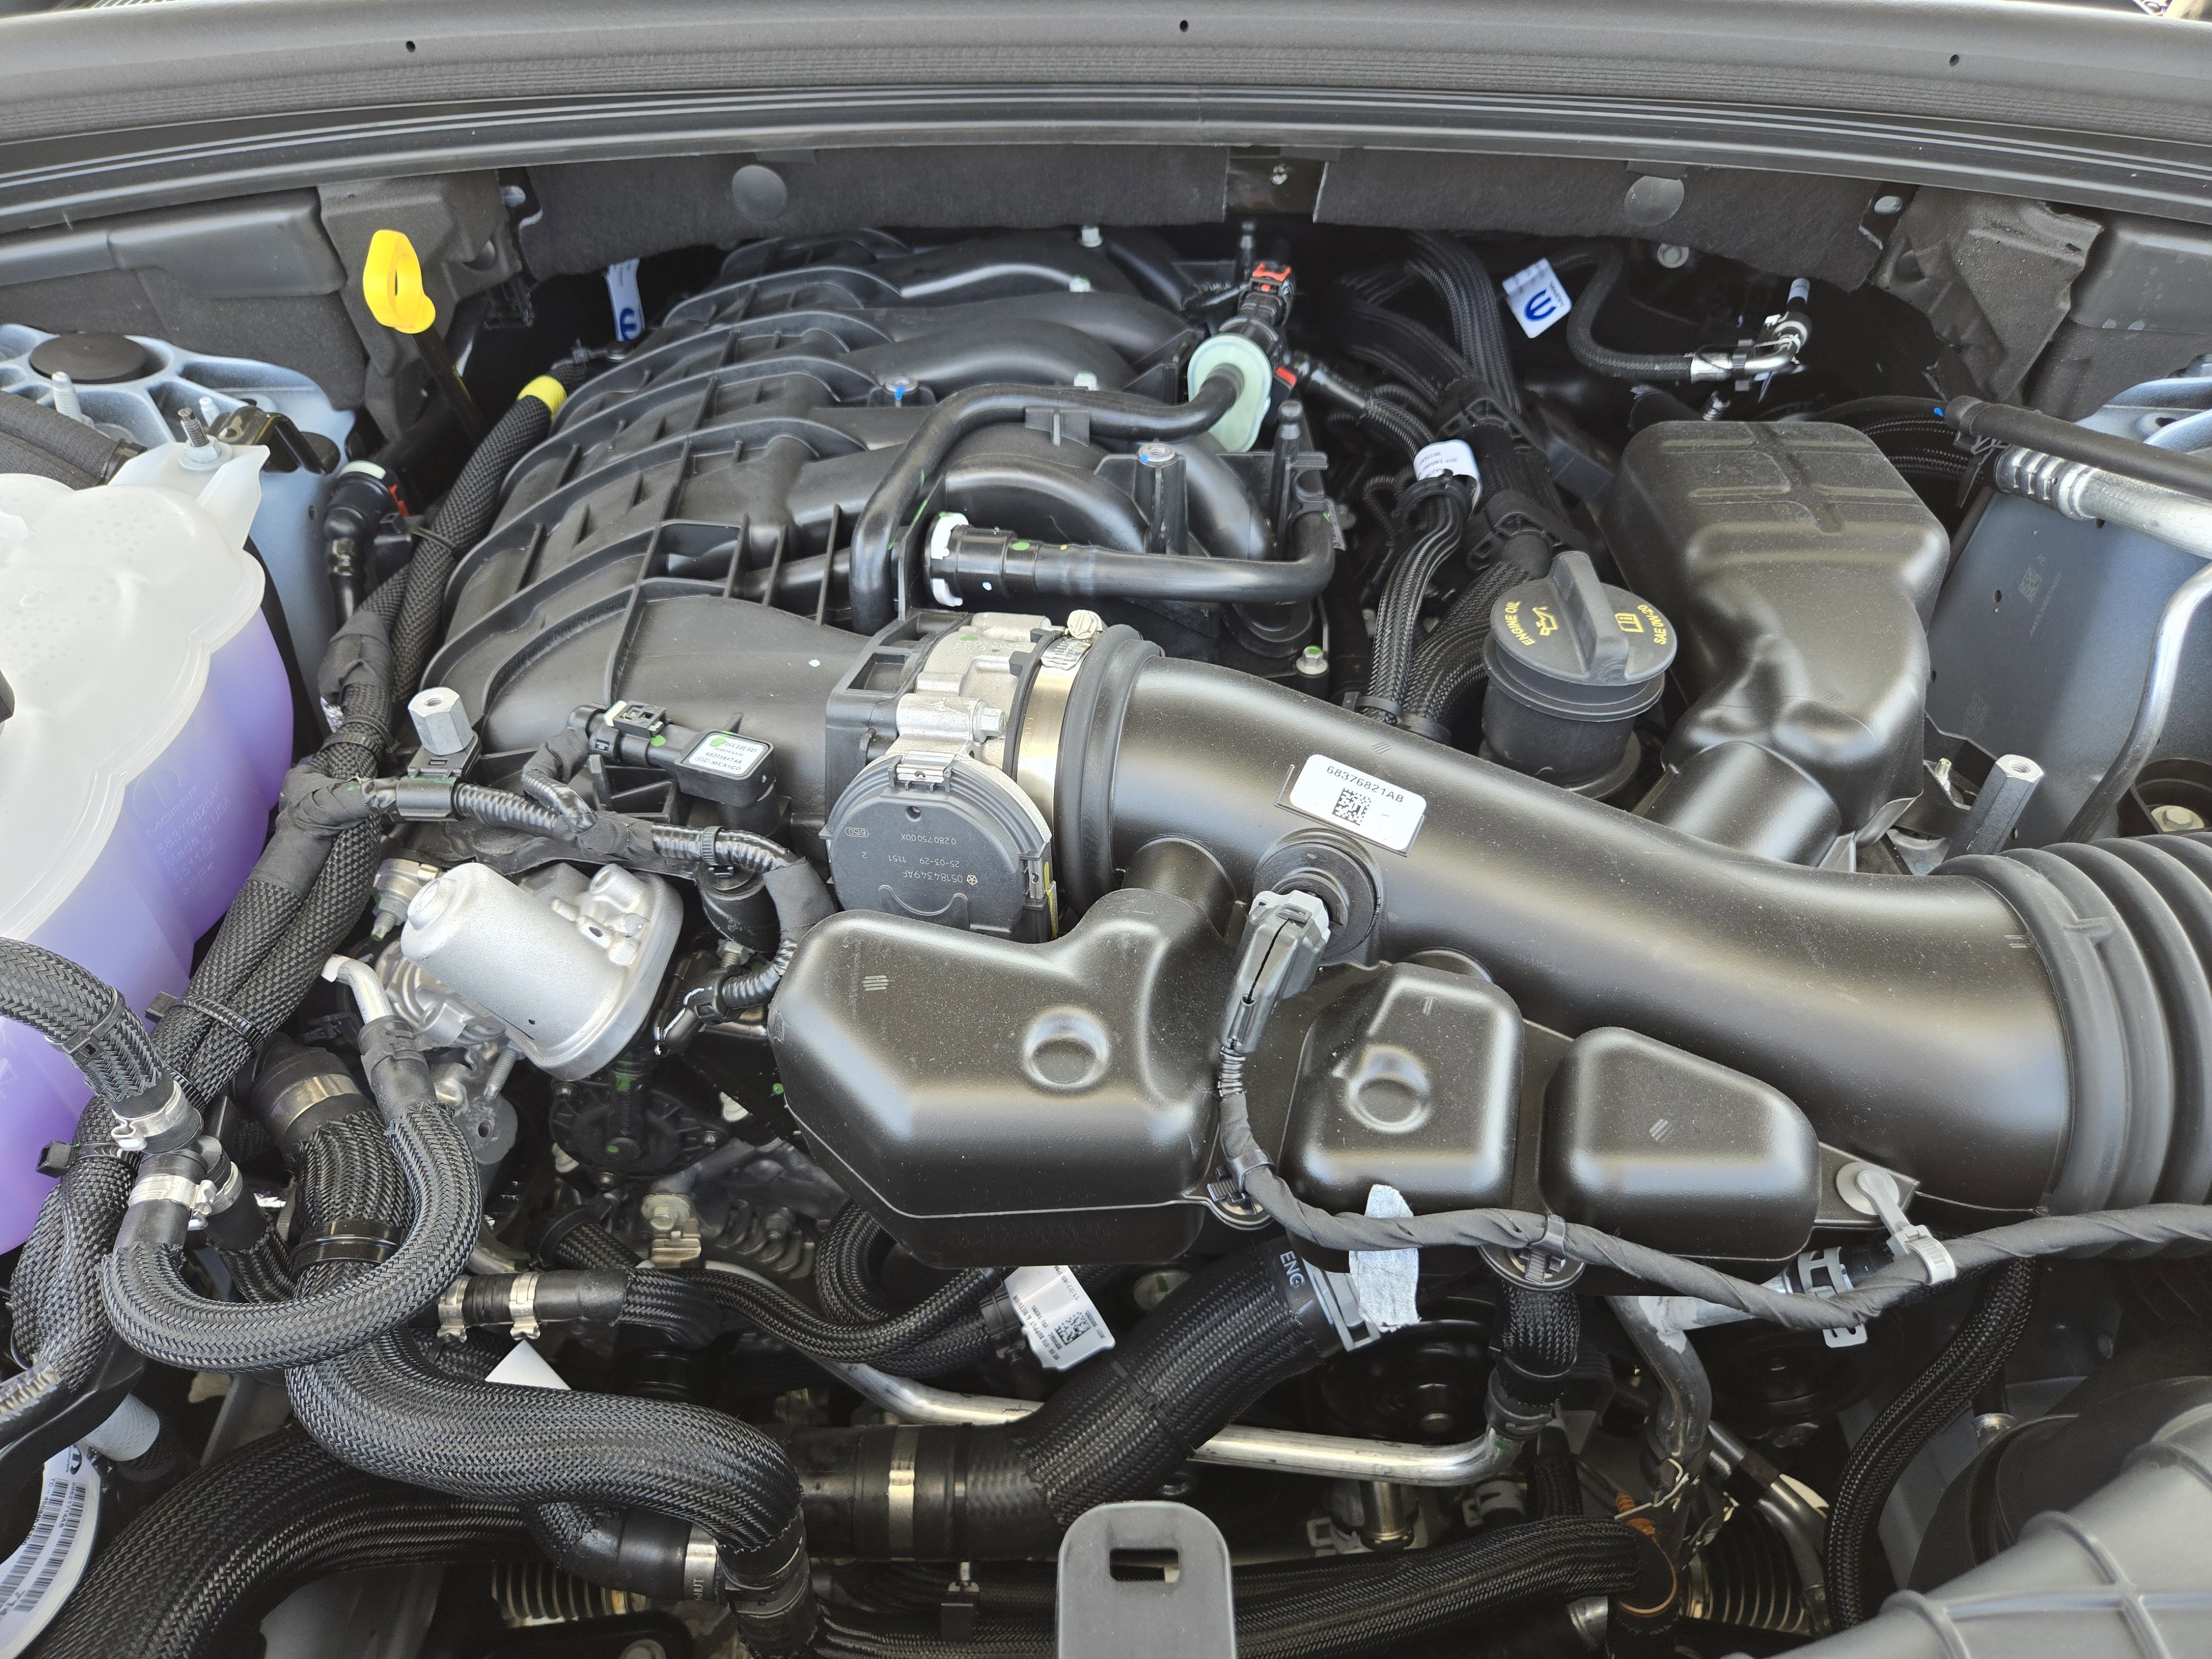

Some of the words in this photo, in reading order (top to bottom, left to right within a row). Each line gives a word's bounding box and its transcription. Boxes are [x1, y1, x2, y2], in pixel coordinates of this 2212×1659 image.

[1505, 601, 1521, 614] OIL
[1637, 604, 1664, 628] 0W-20
[1505, 614, 1536, 646] ENGINE
[1653, 627, 1667, 645] SAE
[711, 761, 741, 771] MEXICO
[1327, 766, 1404, 802] 68376821AB
[164, 837, 200, 870] Made
[200, 825, 211, 837] in
[211, 796, 231, 824] USA
[848, 828, 867, 837] 6150
[934, 836, 950, 844] 280
[919, 857, 960, 868] 25-03-29
[902, 869, 963, 883] 05184349AF
[1280, 1250, 1305, 1288] ENG
[1013, 1295, 1029, 1316] RETURN
[1030, 1321, 1045, 1339] SUPPLY
